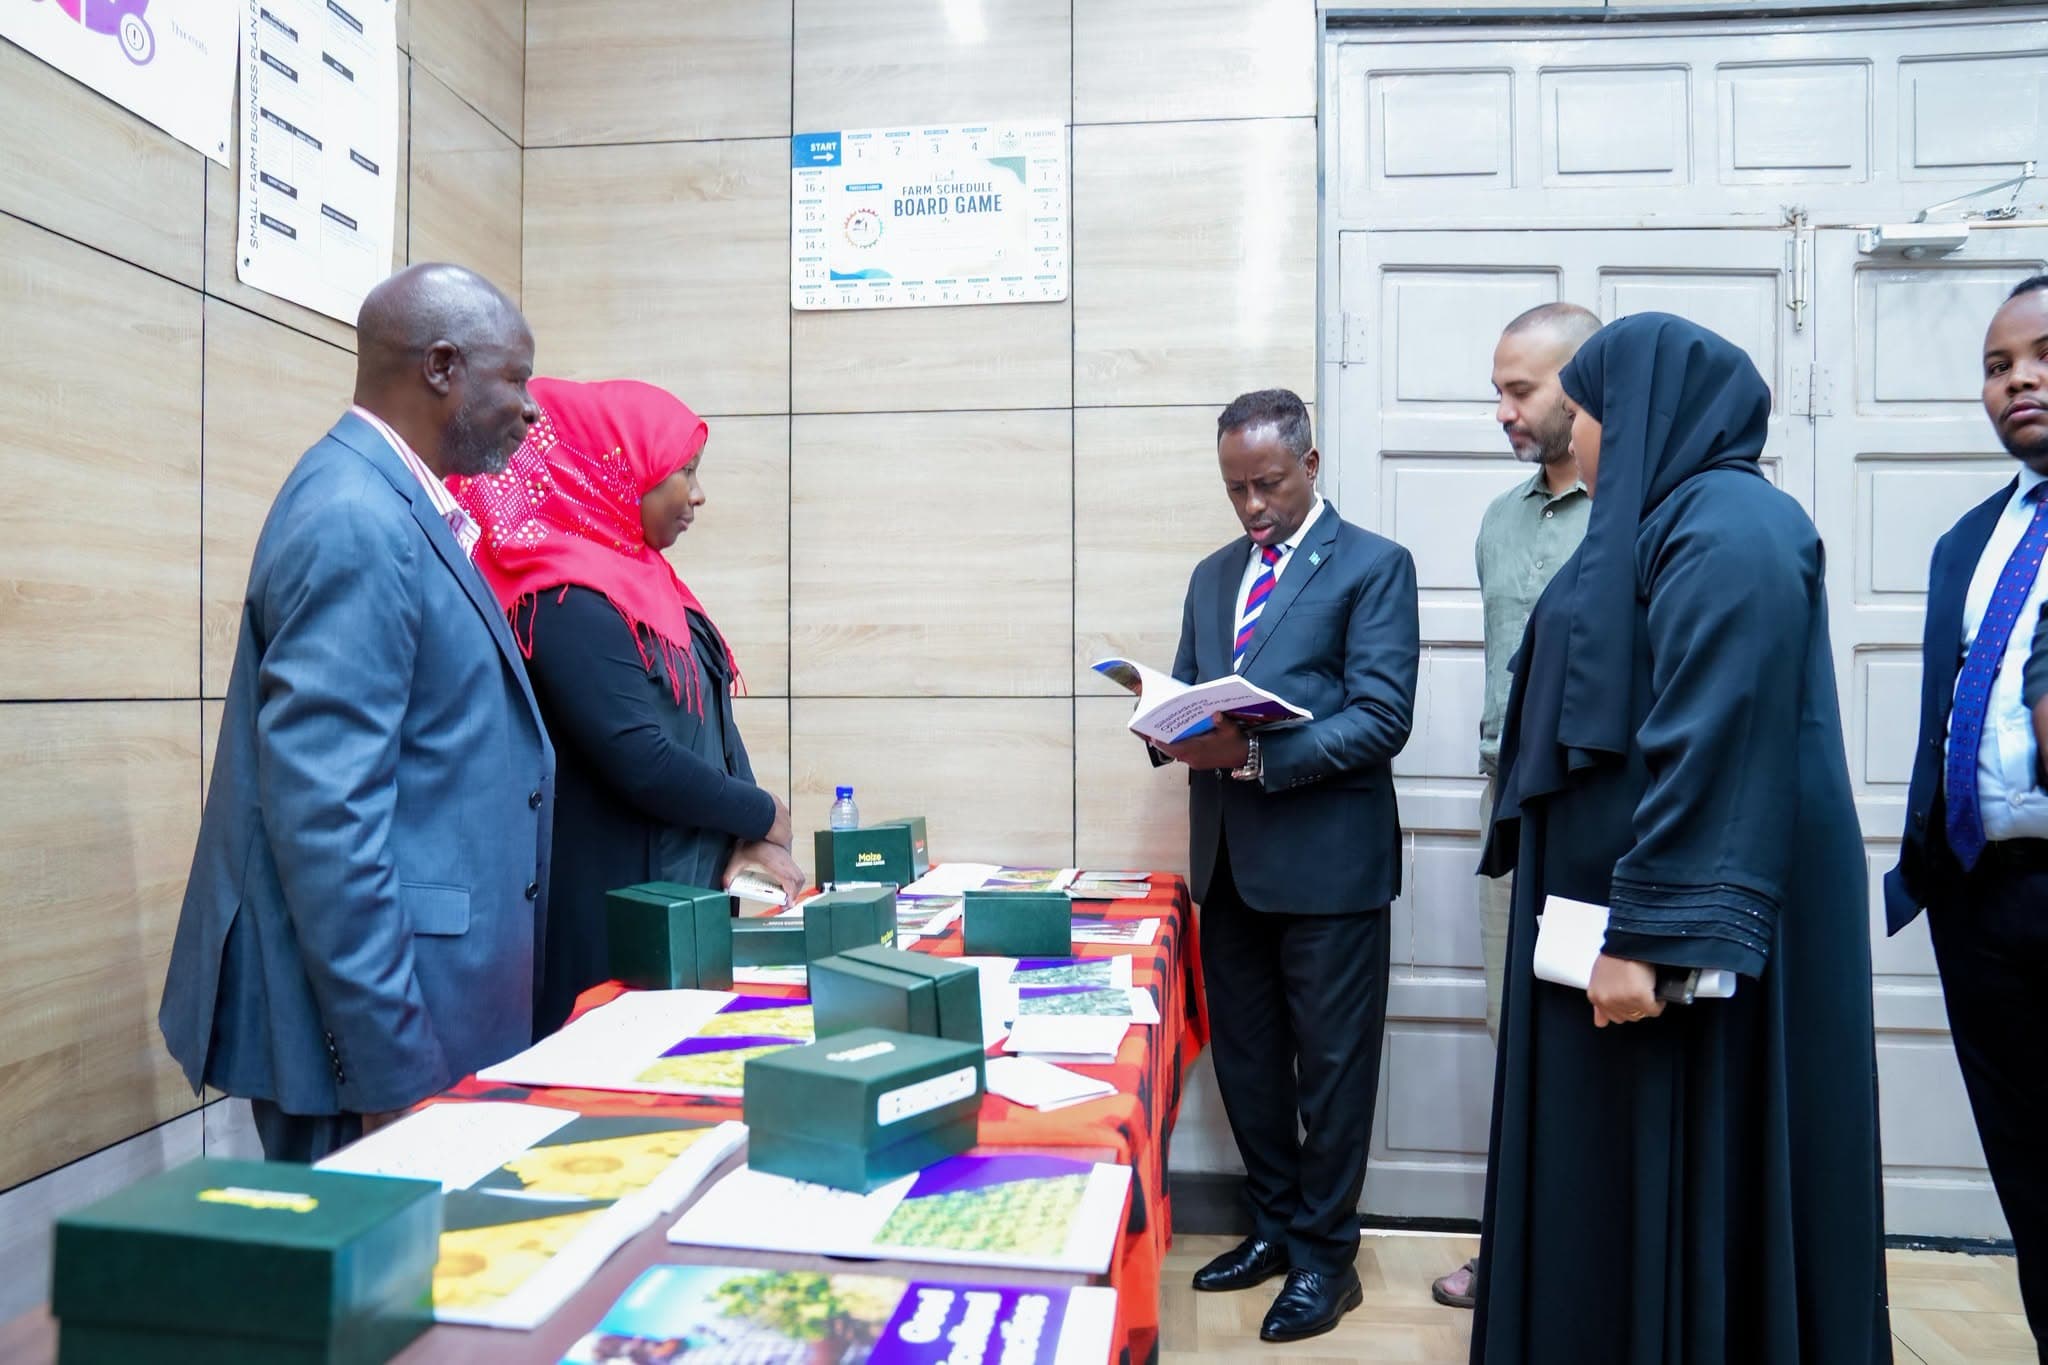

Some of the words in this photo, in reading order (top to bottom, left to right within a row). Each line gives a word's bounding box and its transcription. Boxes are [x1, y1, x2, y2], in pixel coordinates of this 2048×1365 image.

[249, 17, 258, 61] PLAN
[249, 63, 258, 144] BUSINESS
[810, 142, 838, 152] START
[249, 147, 258, 193] FARM
[805, 183, 815, 193] 16
[902, 184, 932, 196] FARM
[936, 181, 993, 195] SCHEDULE
[894, 197, 948, 217] BOARD
[955, 194, 1003, 214] GAME
[805, 211, 815, 222] 15
[249, 198, 258, 249] SMALL
[805, 240, 815, 250] 14
[805, 269, 815, 279] 13
[805, 296, 815, 306] 12
[842, 295, 851, 305] 11
[875, 293, 885, 303] 10
